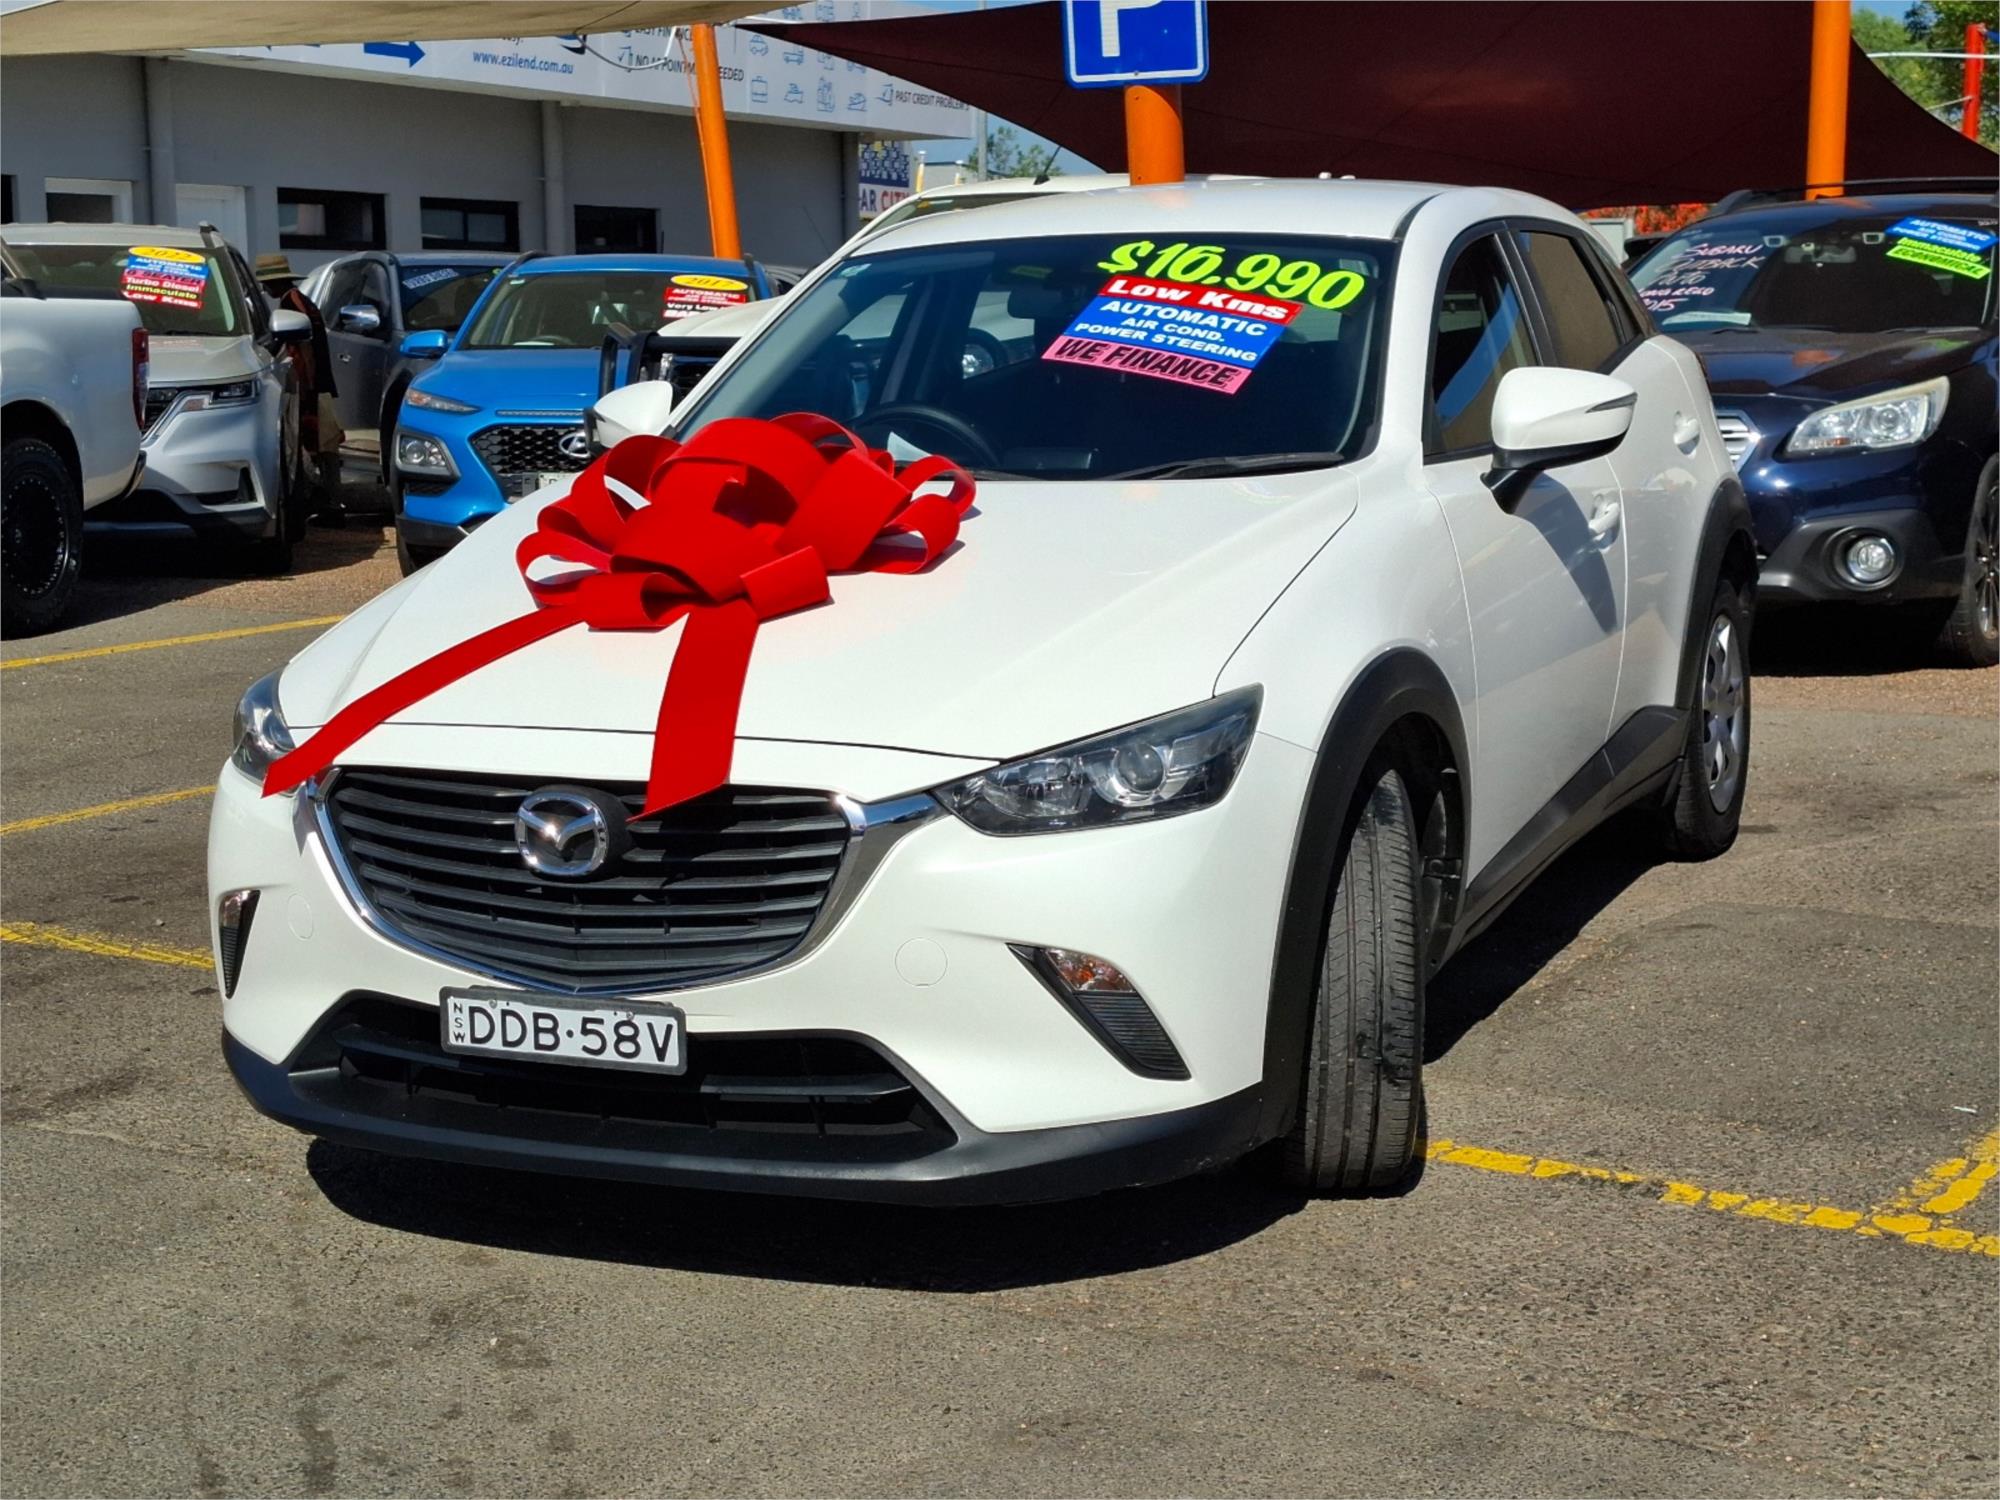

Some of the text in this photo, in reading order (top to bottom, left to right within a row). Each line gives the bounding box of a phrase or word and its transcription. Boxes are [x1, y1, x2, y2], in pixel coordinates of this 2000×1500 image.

[472, 50, 574, 75] www.ezilend.com.au
[718, 66, 744, 82] EEDED
[859, 187, 877, 212] AR
[127, 276, 200, 292] Turbo Diesel
[1107, 279, 1289, 320] Low Kms
[1101, 299, 1268, 337] AUTOMATIC
[1121, 317, 1226, 342] AIR COND.
[1073, 322, 1259, 363] POWER STEERING
[1052, 338, 1239, 388] WE FINANCE
